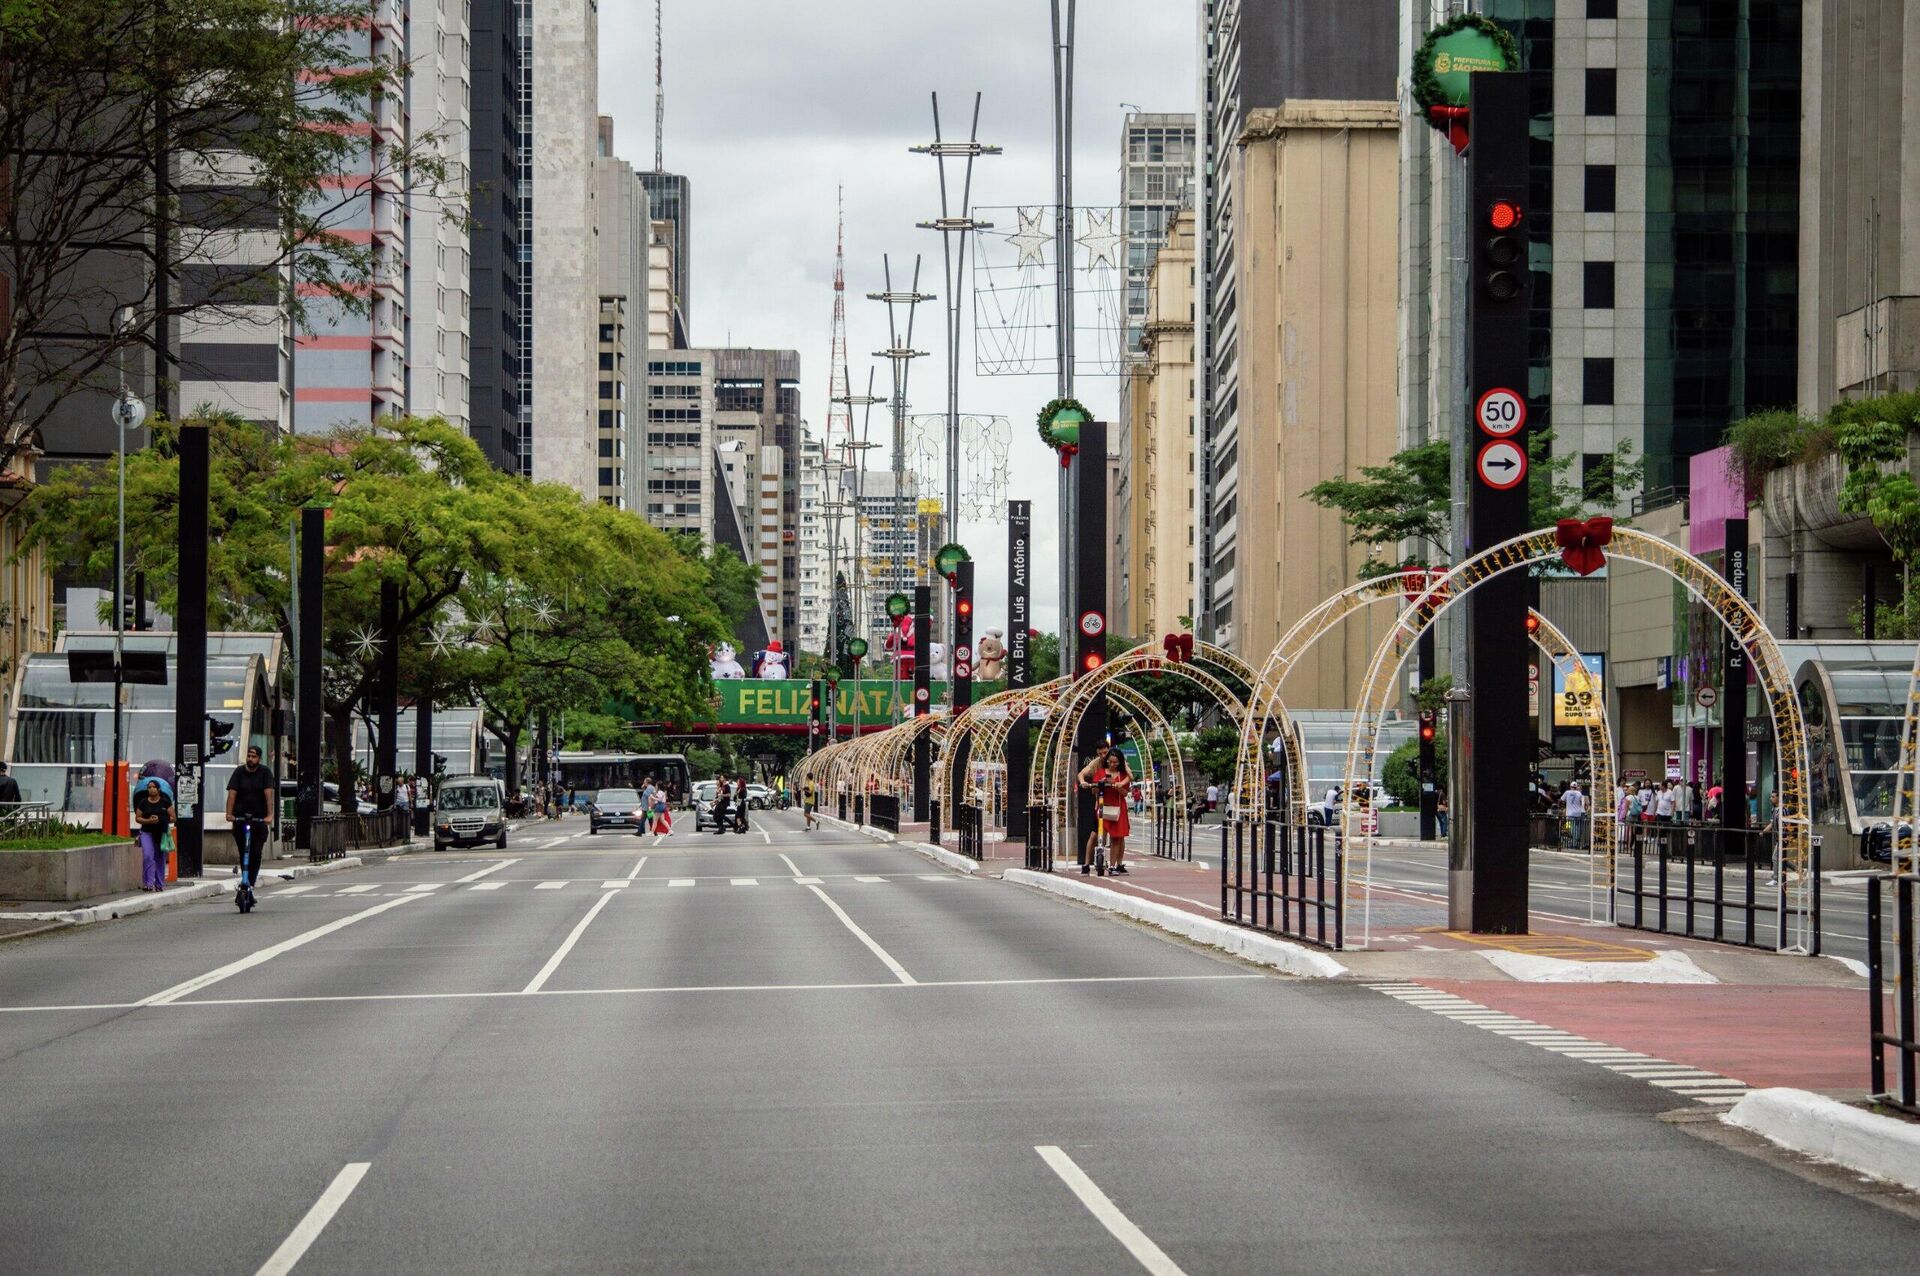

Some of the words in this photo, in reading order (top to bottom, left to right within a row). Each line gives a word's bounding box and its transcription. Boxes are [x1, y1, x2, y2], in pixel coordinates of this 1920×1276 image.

[1486, 401, 1516, 422] 50
[1013, 538, 1025, 587] Antônio
[1730, 550, 1745, 597] ampaio
[959, 649, 969, 657] 50
[1013, 629, 1027, 659] Brig.
[1730, 654, 1742, 667] R.
[1013, 662, 1025, 683] Av.
[739, 688, 813, 715] FELIZ
[835, 690, 915, 715] NATA
[1564, 691, 1593, 706] 99
